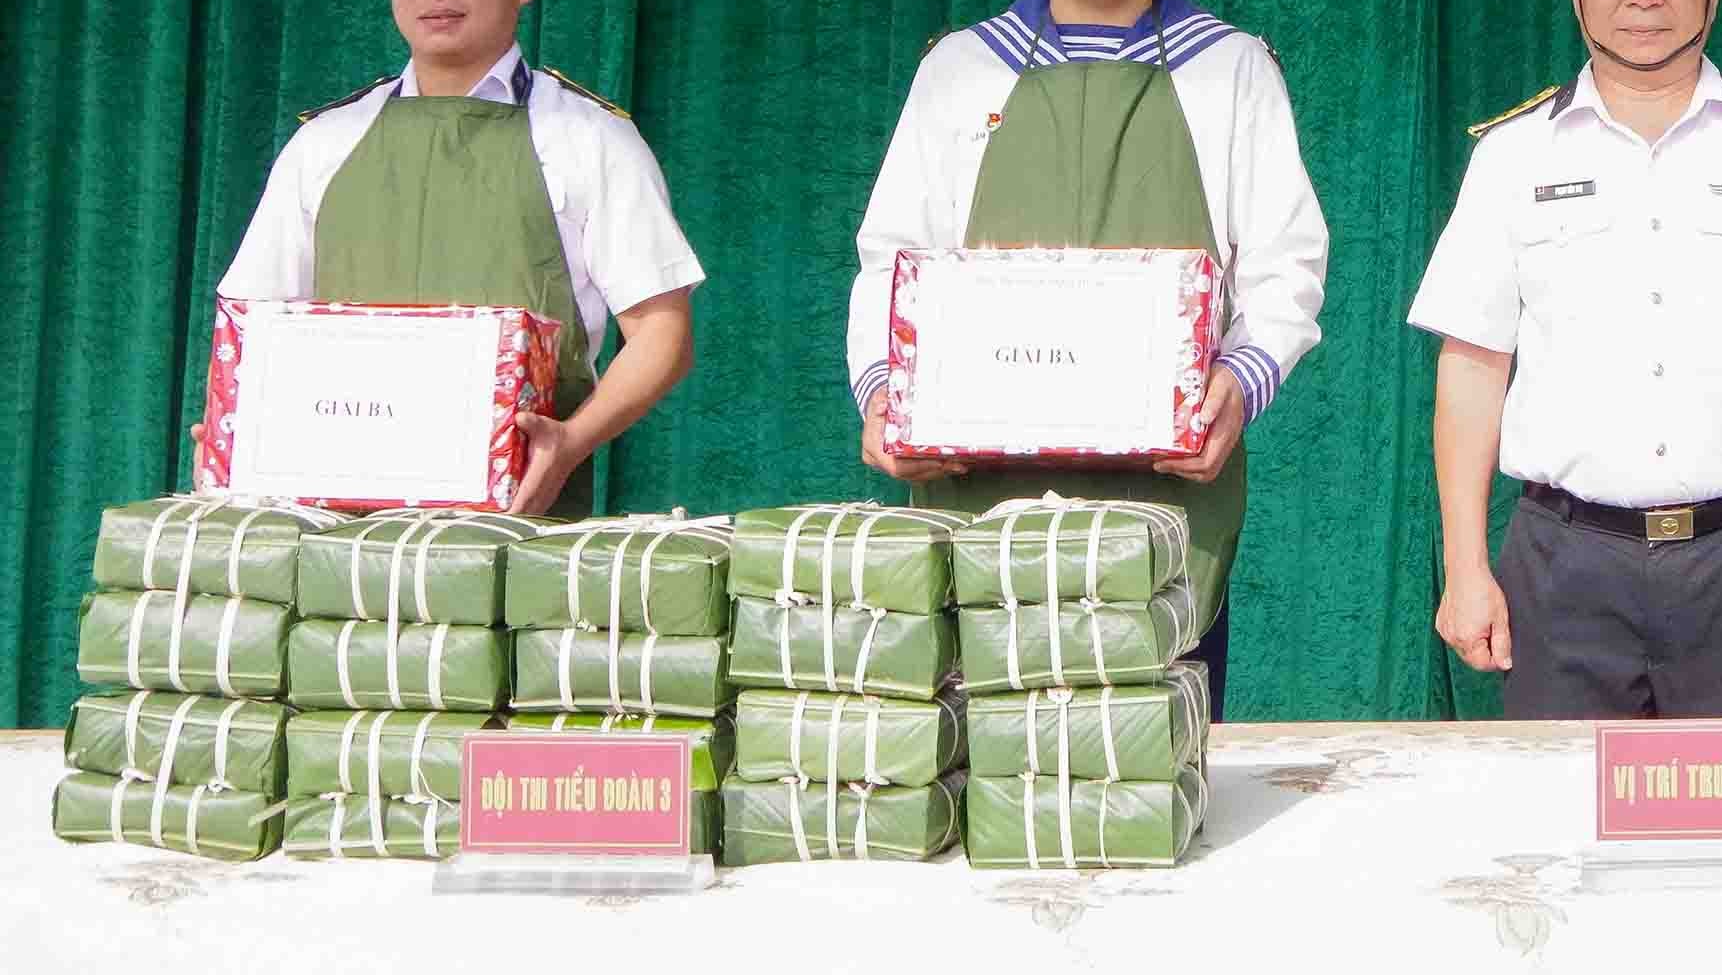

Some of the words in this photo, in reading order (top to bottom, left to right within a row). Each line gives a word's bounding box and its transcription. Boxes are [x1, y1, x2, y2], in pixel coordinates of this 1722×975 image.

[1050, 348, 1076, 364] BA
[368, 400, 394, 417] BA
[481, 769, 513, 819] ĐỘI
[519, 776, 548, 811] THI
[554, 764, 597, 811] TIỂU
[603, 768, 655, 811] ĐOÀN
[660, 776, 672, 811] 3
[1613, 765, 1636, 806] VỊ
[1643, 757, 1680, 800] TRÍ
